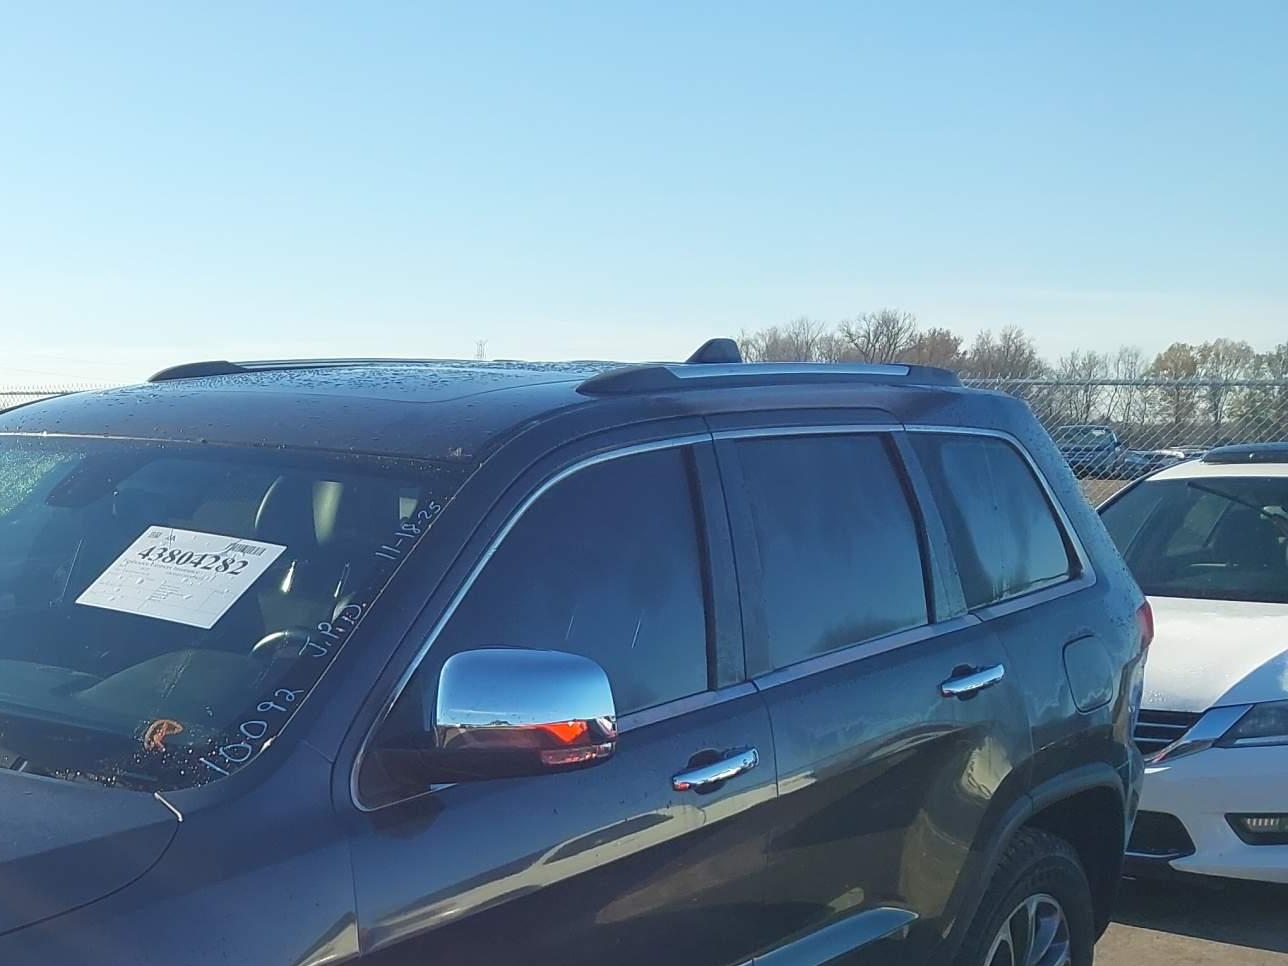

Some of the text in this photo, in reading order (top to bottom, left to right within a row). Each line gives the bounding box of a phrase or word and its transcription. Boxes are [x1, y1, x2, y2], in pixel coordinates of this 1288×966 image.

[137, 545, 249, 576] 43804282
[199, 689, 304, 776] 10092
[375, 501, 441, 560] 11-18-25
